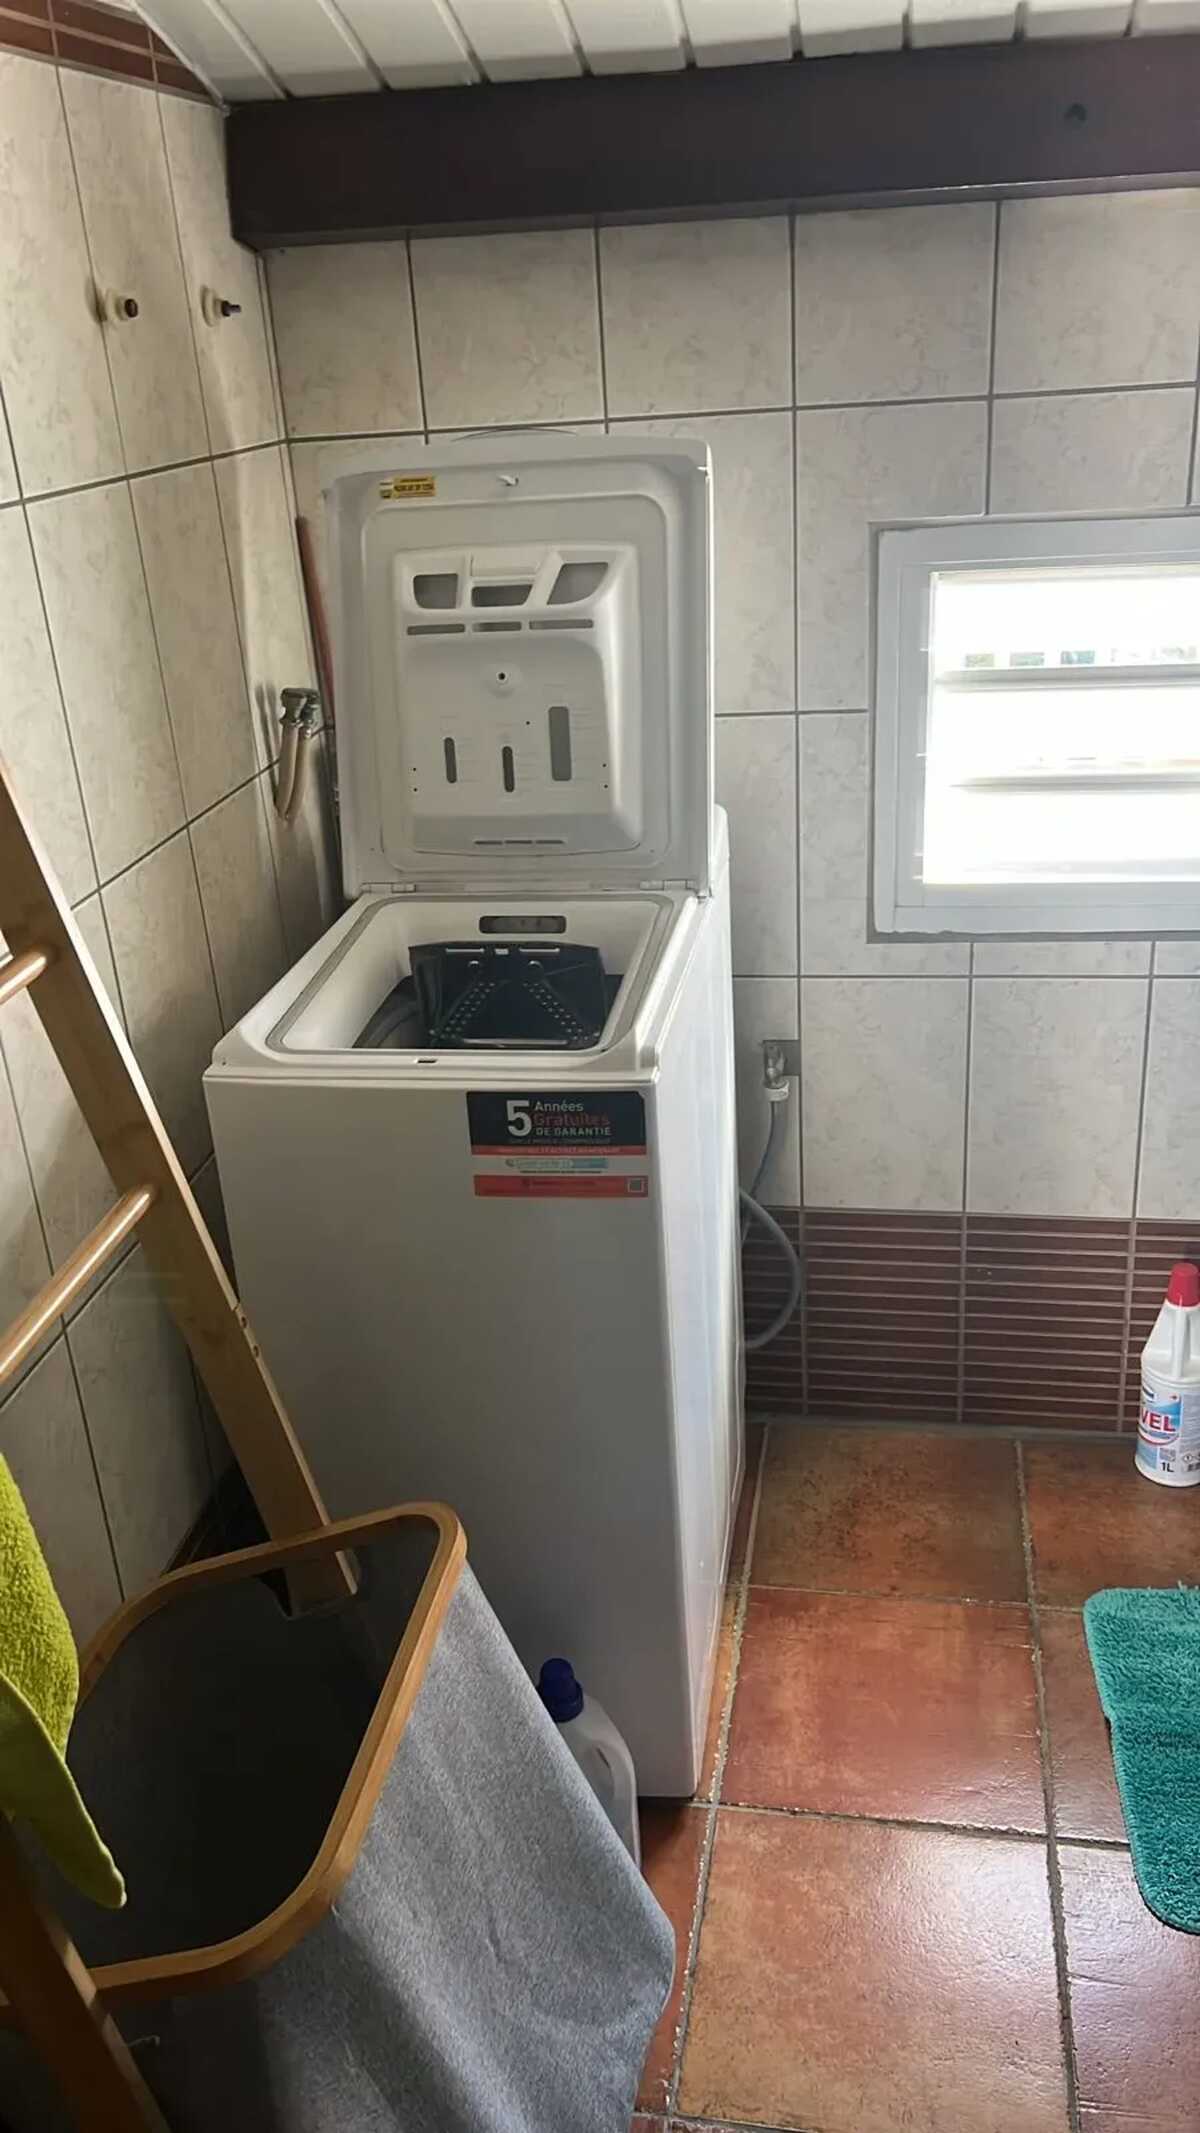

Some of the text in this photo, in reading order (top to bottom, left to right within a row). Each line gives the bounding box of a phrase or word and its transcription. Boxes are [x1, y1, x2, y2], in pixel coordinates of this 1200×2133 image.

[535, 1100, 585, 1112] Années
[506, 1099, 532, 1136] 5
[533, 1112, 611, 1127] Gratuites
[535, 1127, 612, 1136] DE GARANTIE
[1160, 1461, 1174, 1473] 1L
